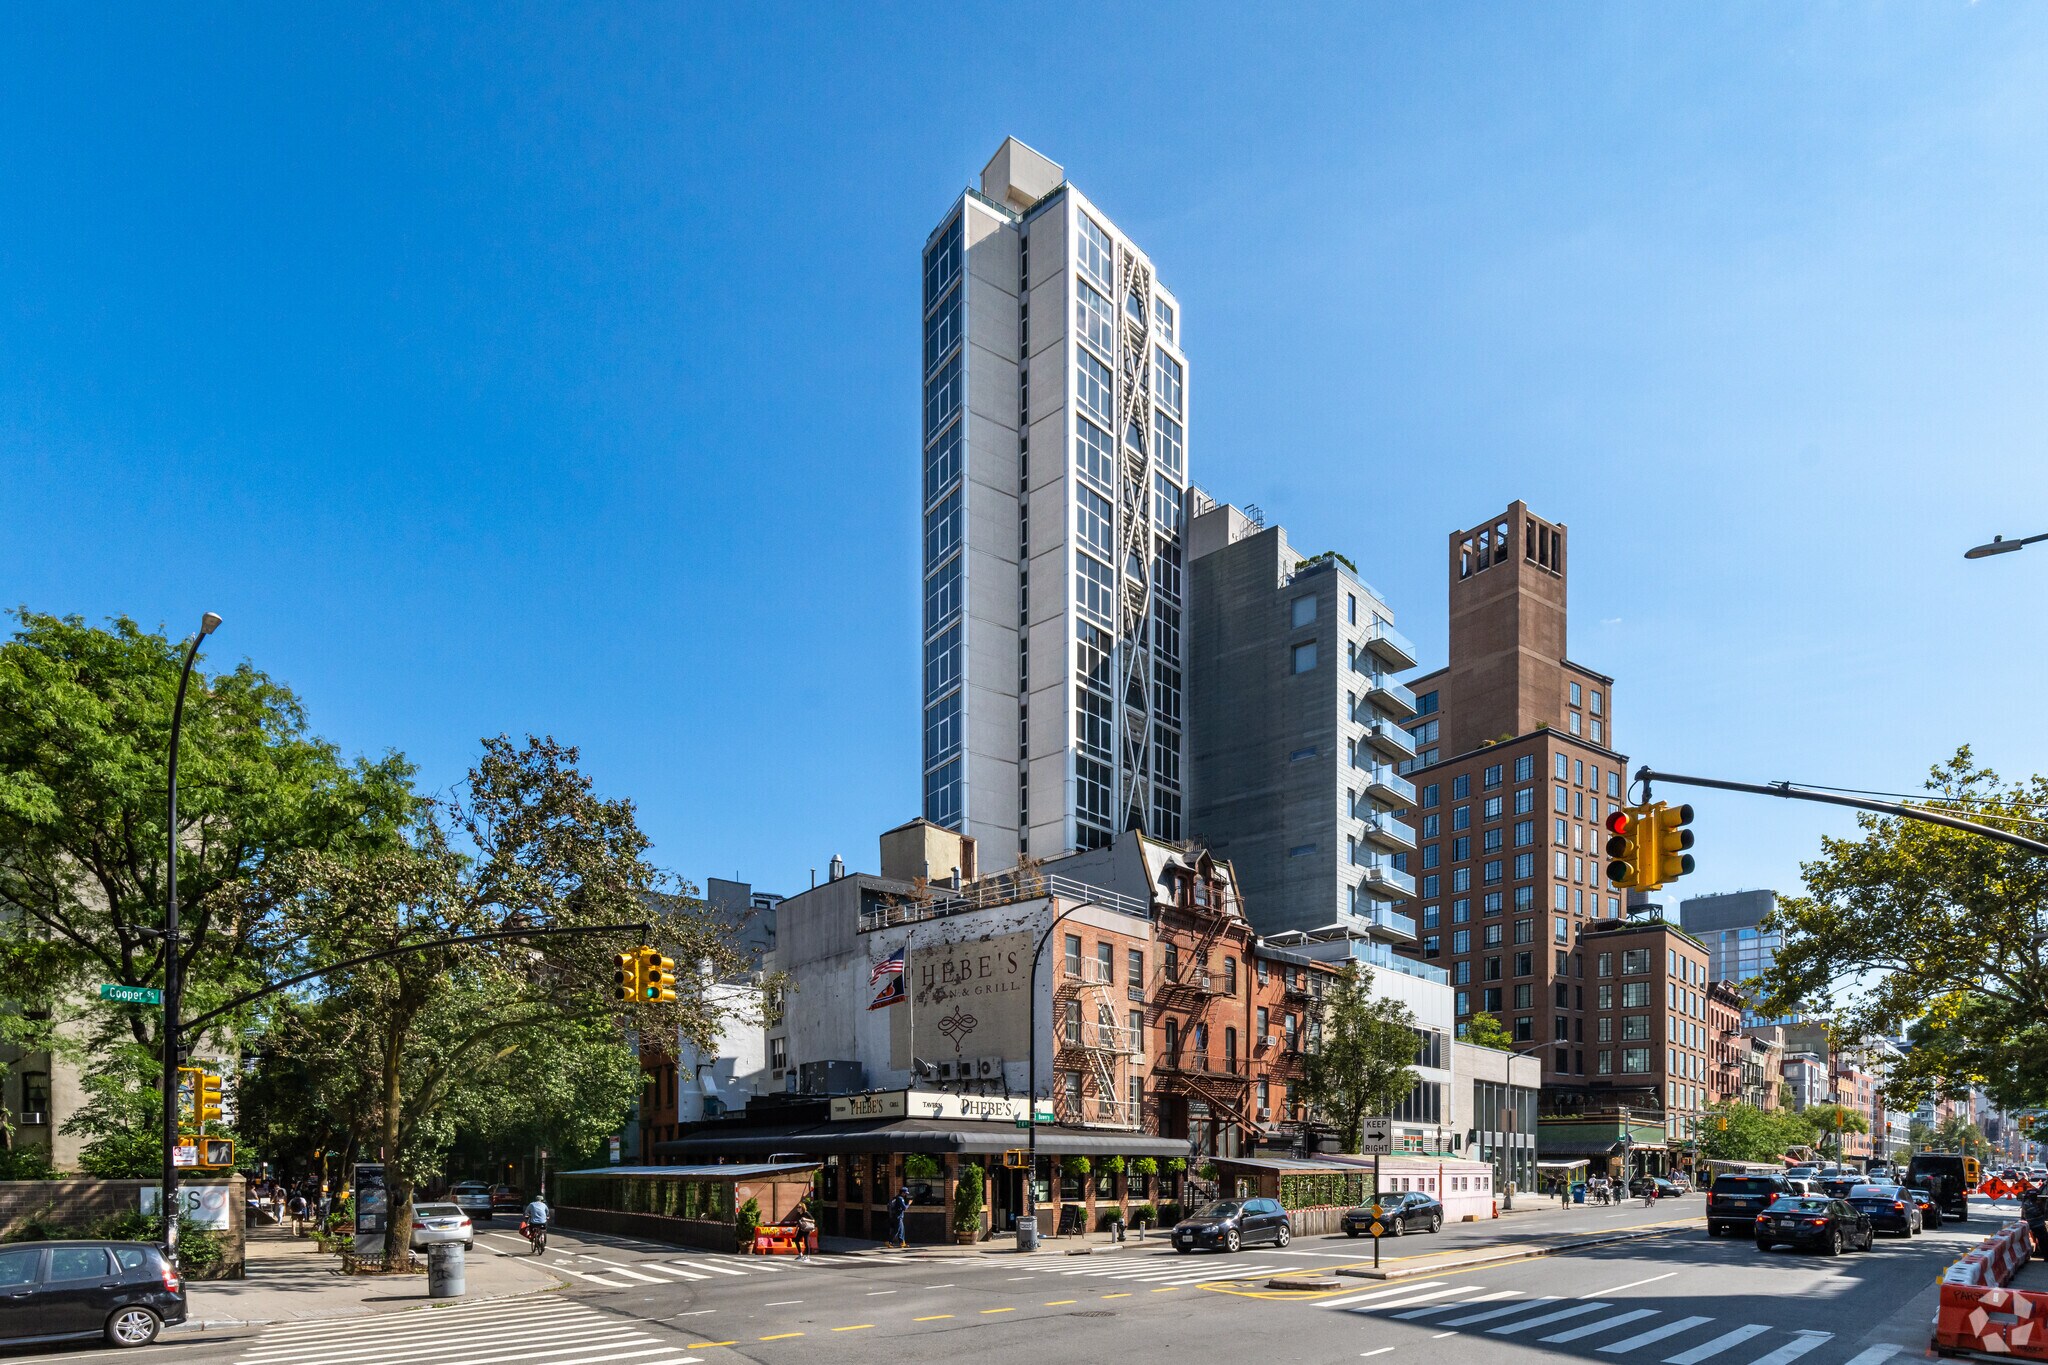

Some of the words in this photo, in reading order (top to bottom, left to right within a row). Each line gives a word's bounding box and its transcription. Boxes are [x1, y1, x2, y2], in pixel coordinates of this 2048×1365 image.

[903, 951, 1018, 989] PHEBE'S
[109, 987, 143, 1001] Cooper
[147, 990, 155, 999] Sq
[850, 1099, 883, 1115] PHEBE'S
[961, 1098, 1012, 1117] PHEBE'S
[1366, 1120, 1387, 1128] KEEP
[1365, 1144, 1389, 1152] RIGHT
